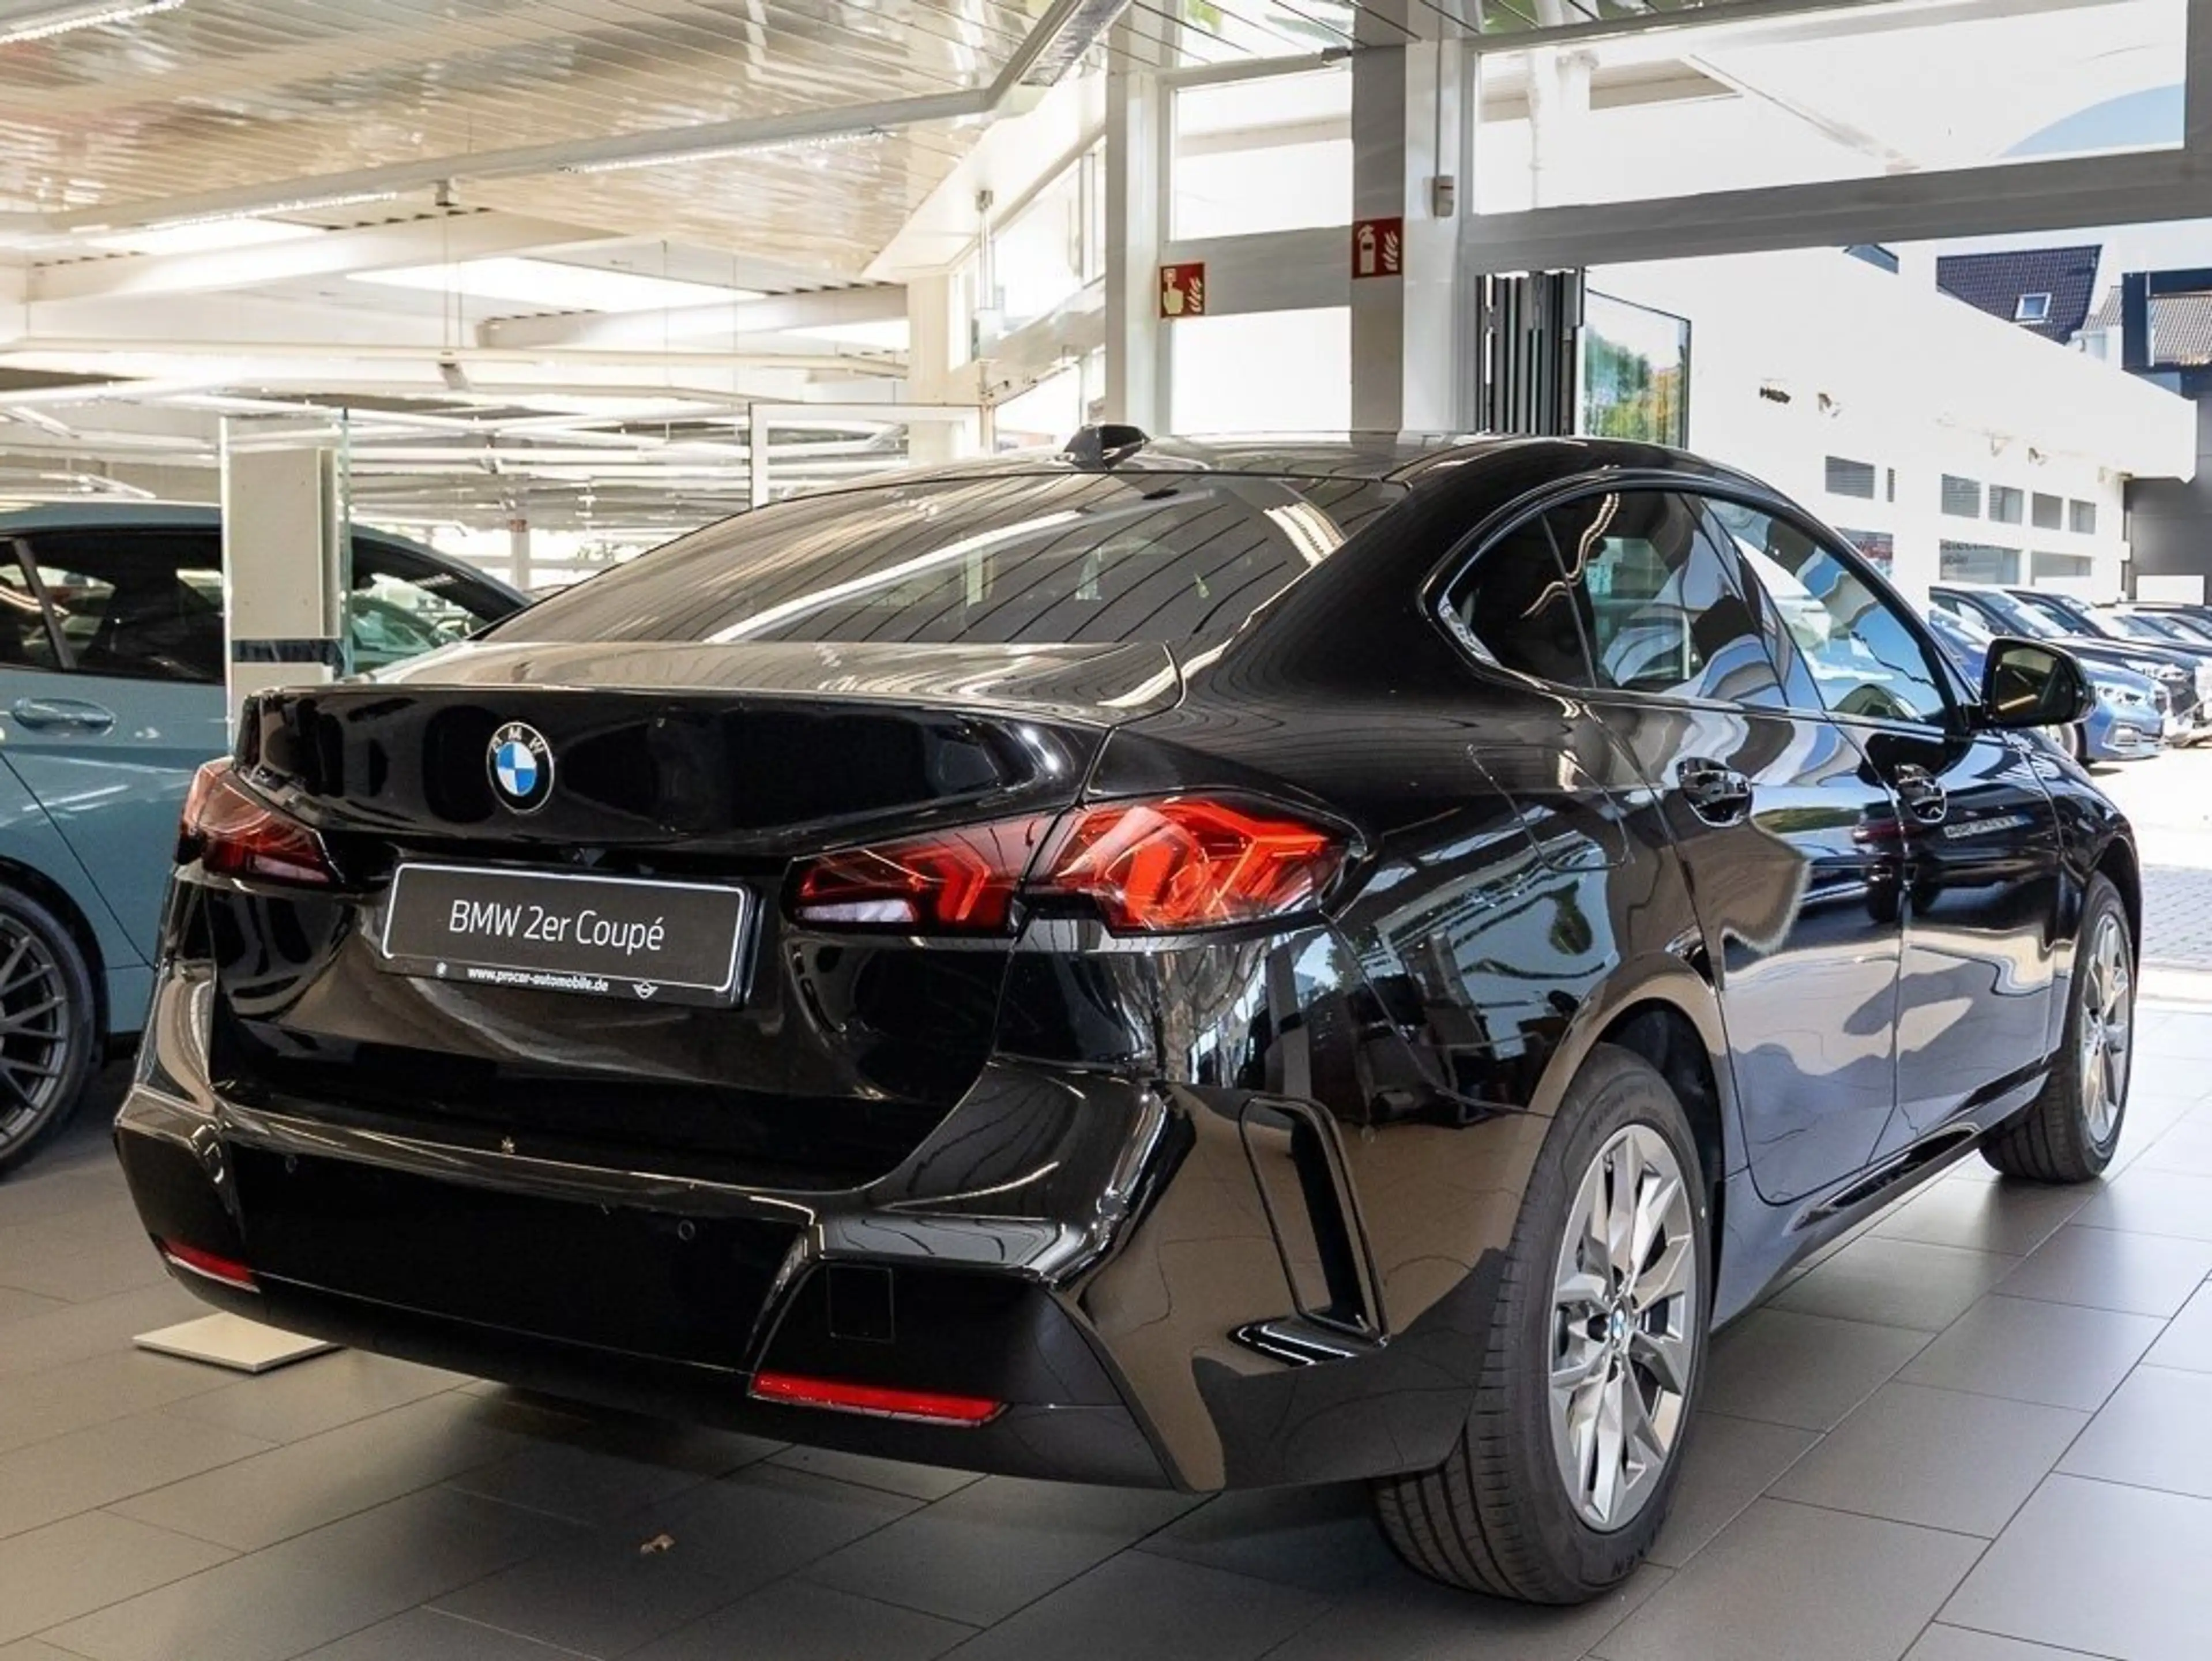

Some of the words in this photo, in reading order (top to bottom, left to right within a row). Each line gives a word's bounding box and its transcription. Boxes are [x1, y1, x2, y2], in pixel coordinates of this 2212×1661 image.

[491, 726, 546, 754] BMW
[449, 899, 522, 937] BMW
[523, 905, 572, 942] 2er
[575, 910, 665, 956] Coupé
[467, 968, 609, 993] www.procar-automobile.de
